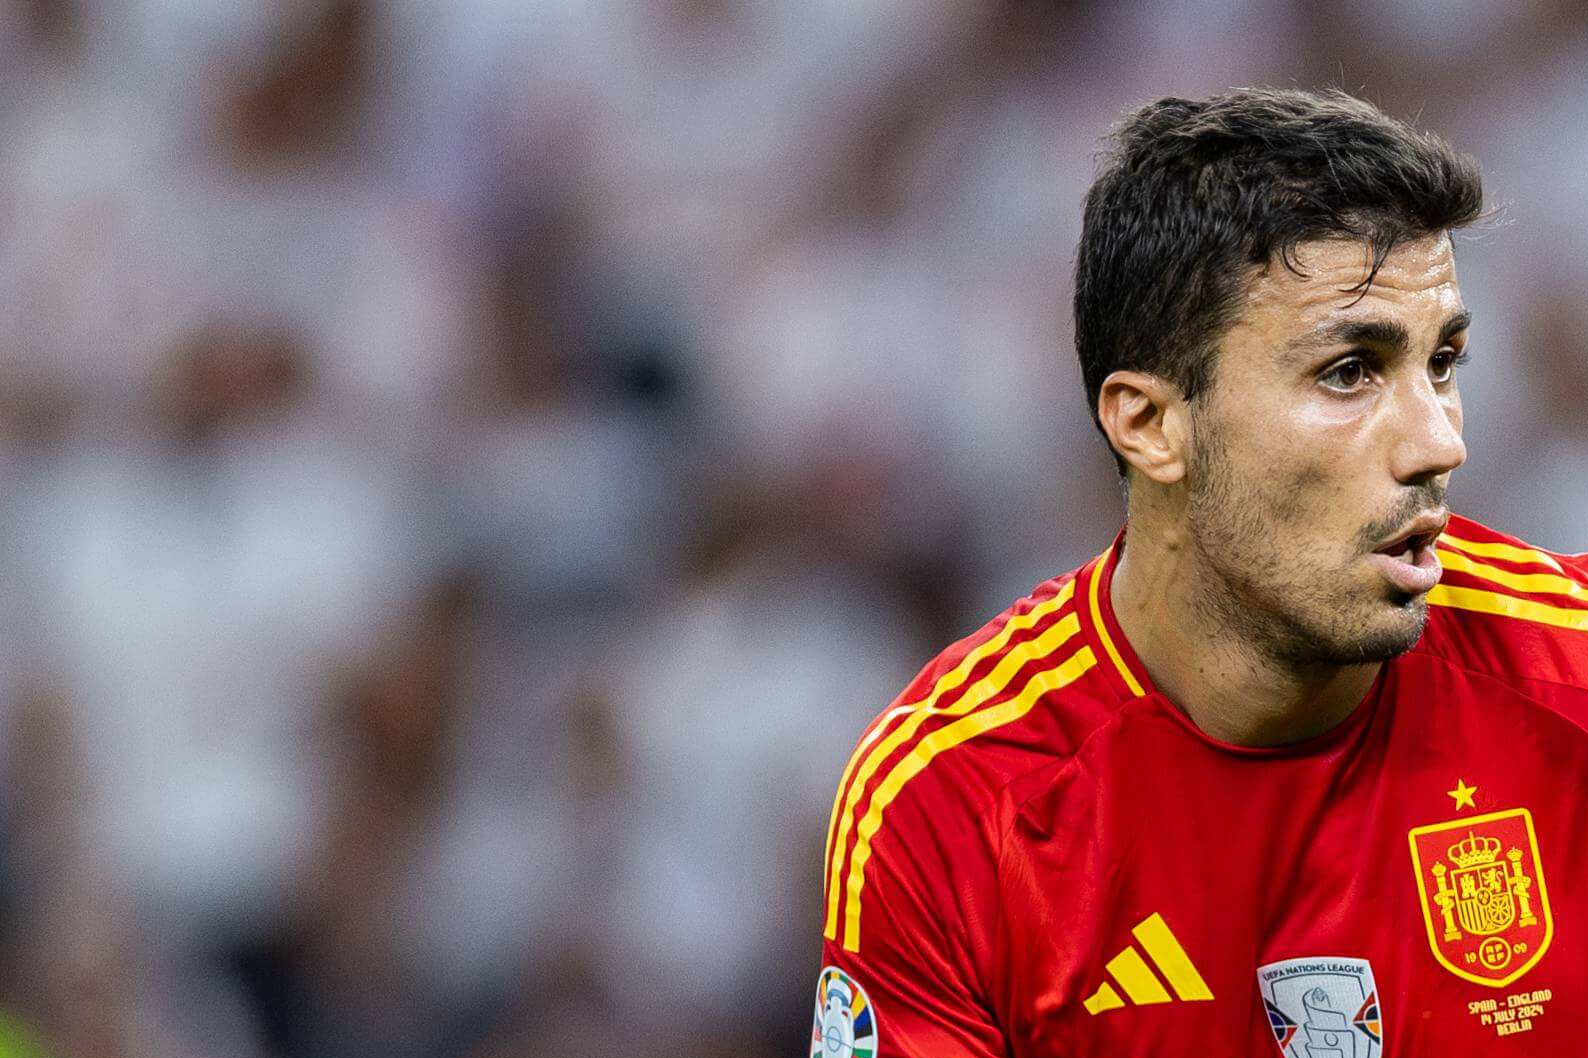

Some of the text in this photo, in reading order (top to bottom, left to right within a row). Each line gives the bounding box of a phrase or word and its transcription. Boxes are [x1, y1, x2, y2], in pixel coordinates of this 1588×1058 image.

[1262, 963, 1365, 981] UEFA NATIONS LEAGUE
[1467, 999, 1498, 1015] SPAIN
[1507, 989, 1552, 1008] ENGLAND
[1480, 1004, 1544, 1026] 14 JULY 2024
[1496, 1019, 1533, 1036] BERLIN
